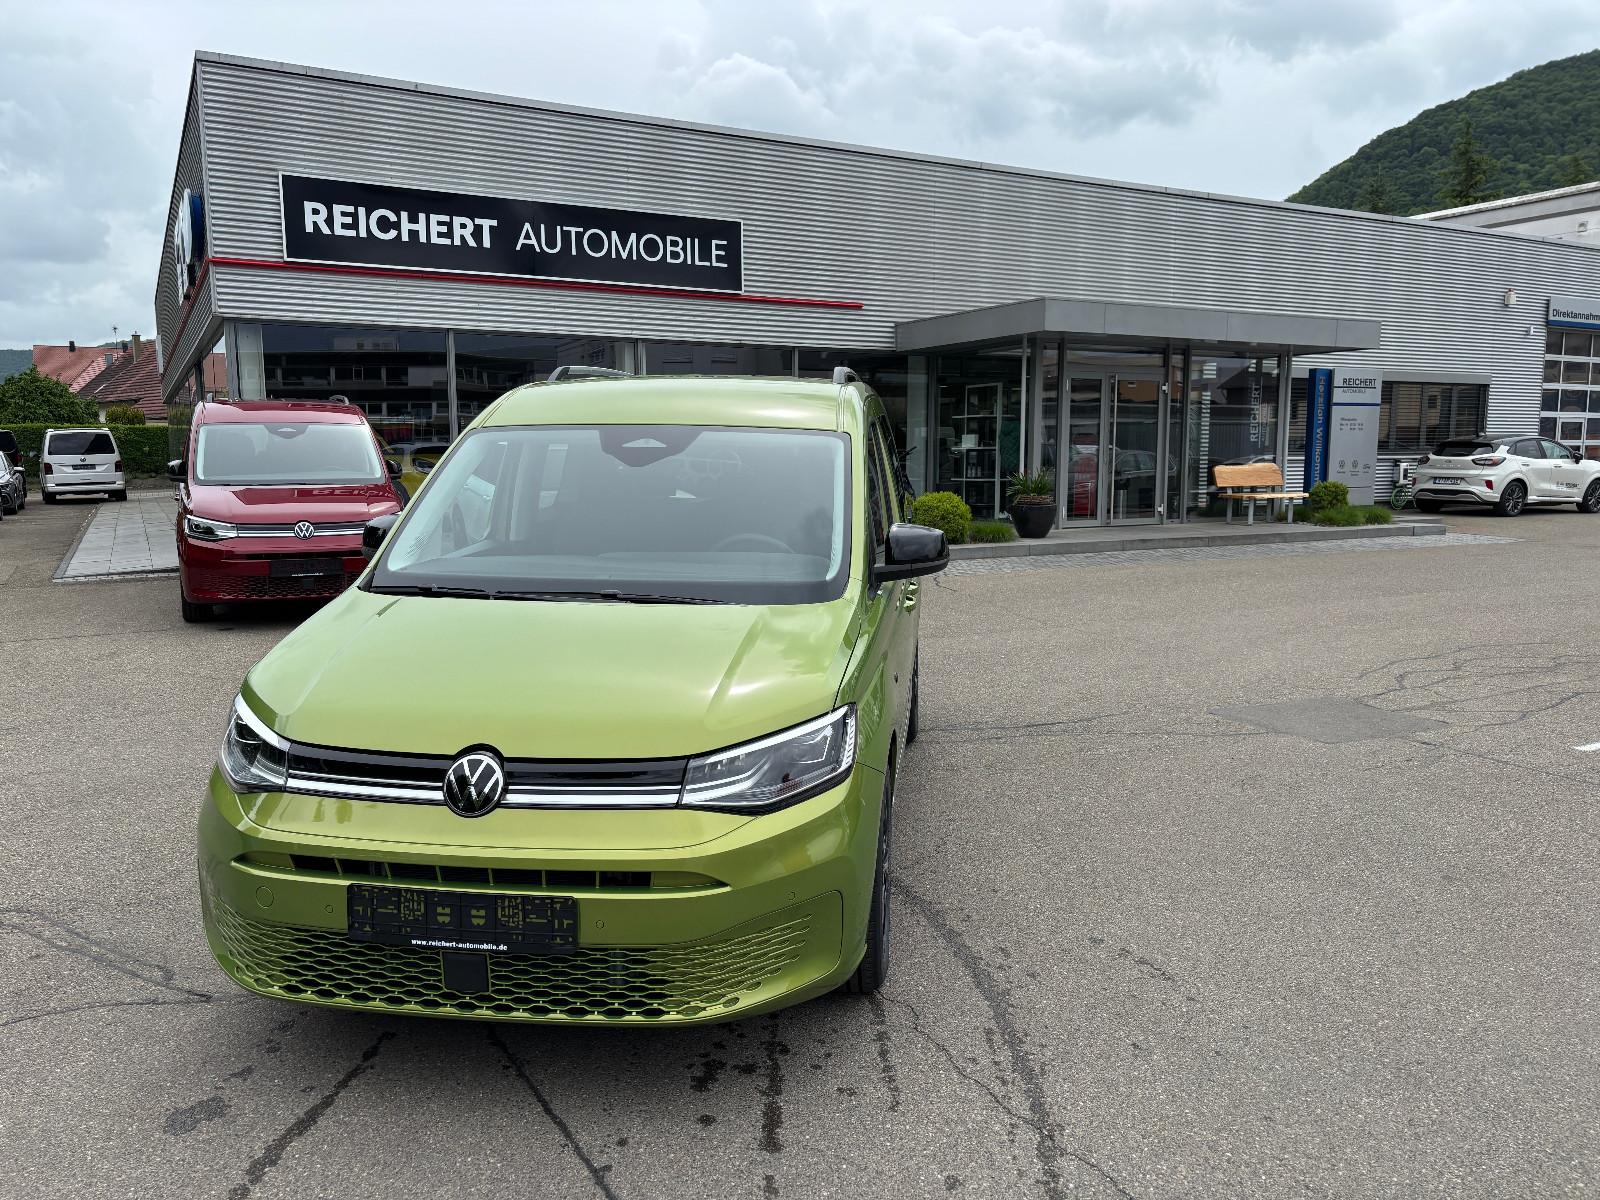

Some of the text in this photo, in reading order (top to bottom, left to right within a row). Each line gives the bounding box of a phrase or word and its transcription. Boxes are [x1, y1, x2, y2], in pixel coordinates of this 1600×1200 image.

[303, 200, 728, 268] REICHERT AUTOMOBILE
[1317, 376, 1326, 424] Herzlich
[1342, 377, 1377, 387] REICHERT
[1249, 383, 1260, 442] REICHERT
[411, 939, 508, 951] www.reichert-automobile.de
